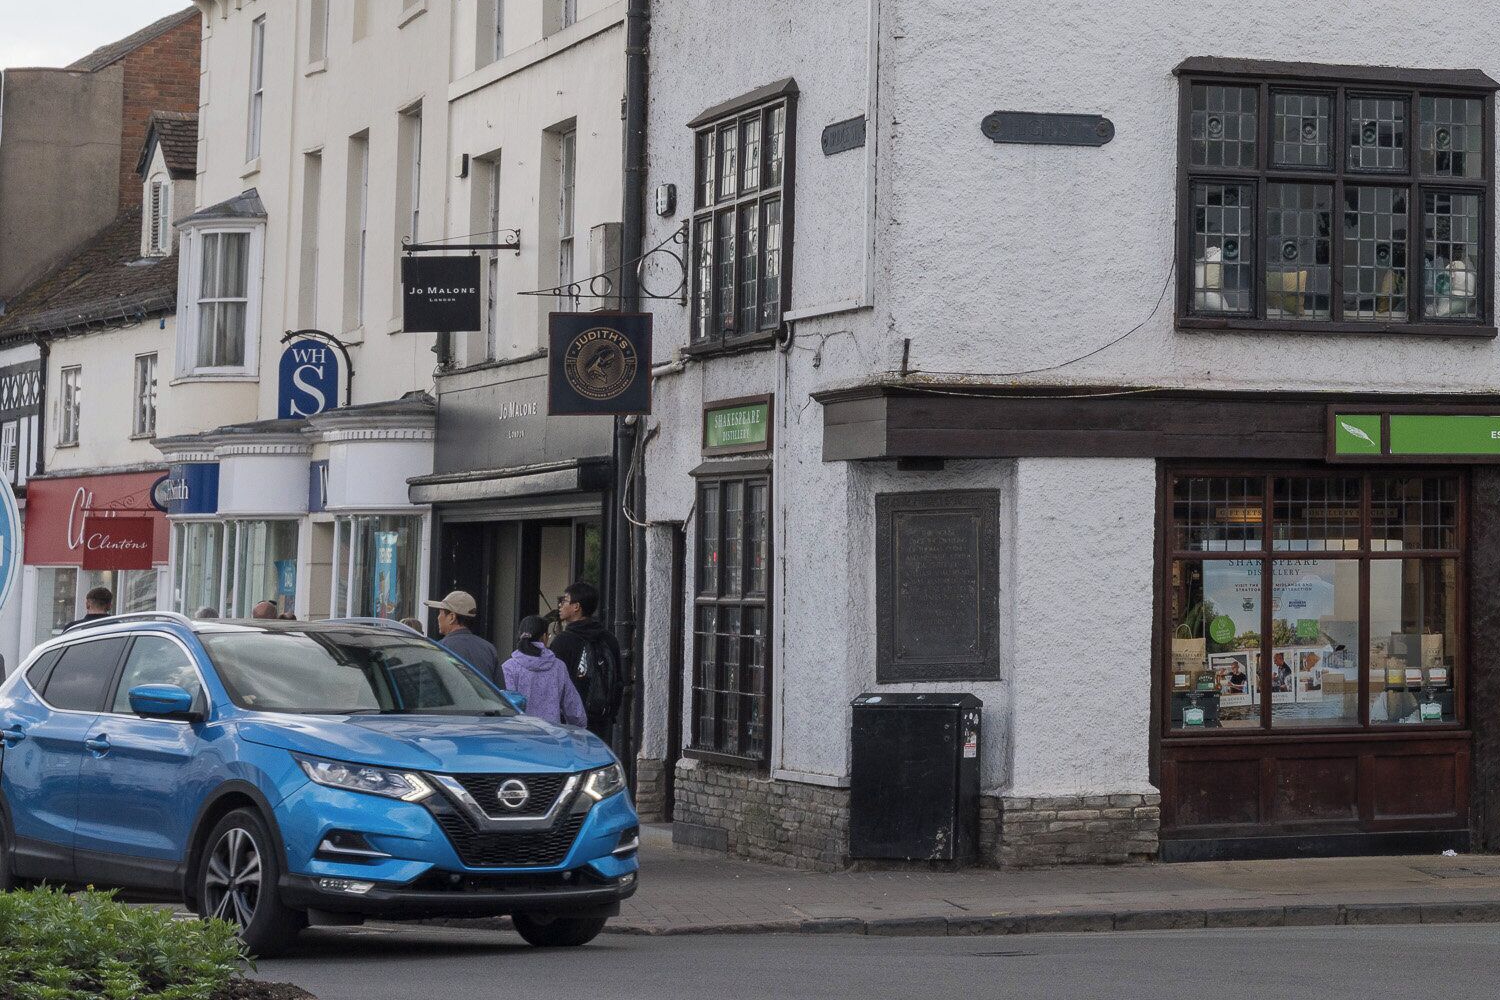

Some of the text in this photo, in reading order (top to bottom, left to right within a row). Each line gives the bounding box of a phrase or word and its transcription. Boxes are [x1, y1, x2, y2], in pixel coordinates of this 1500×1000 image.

[575, 330, 628, 350] JUDITH'S
[292, 348, 326, 363] WH
[290, 364, 326, 416] S
[714, 409, 760, 429] SHAKESPEARE
[722, 428, 750, 442] DISTILLERY
[87, 533, 148, 550] Clintons
